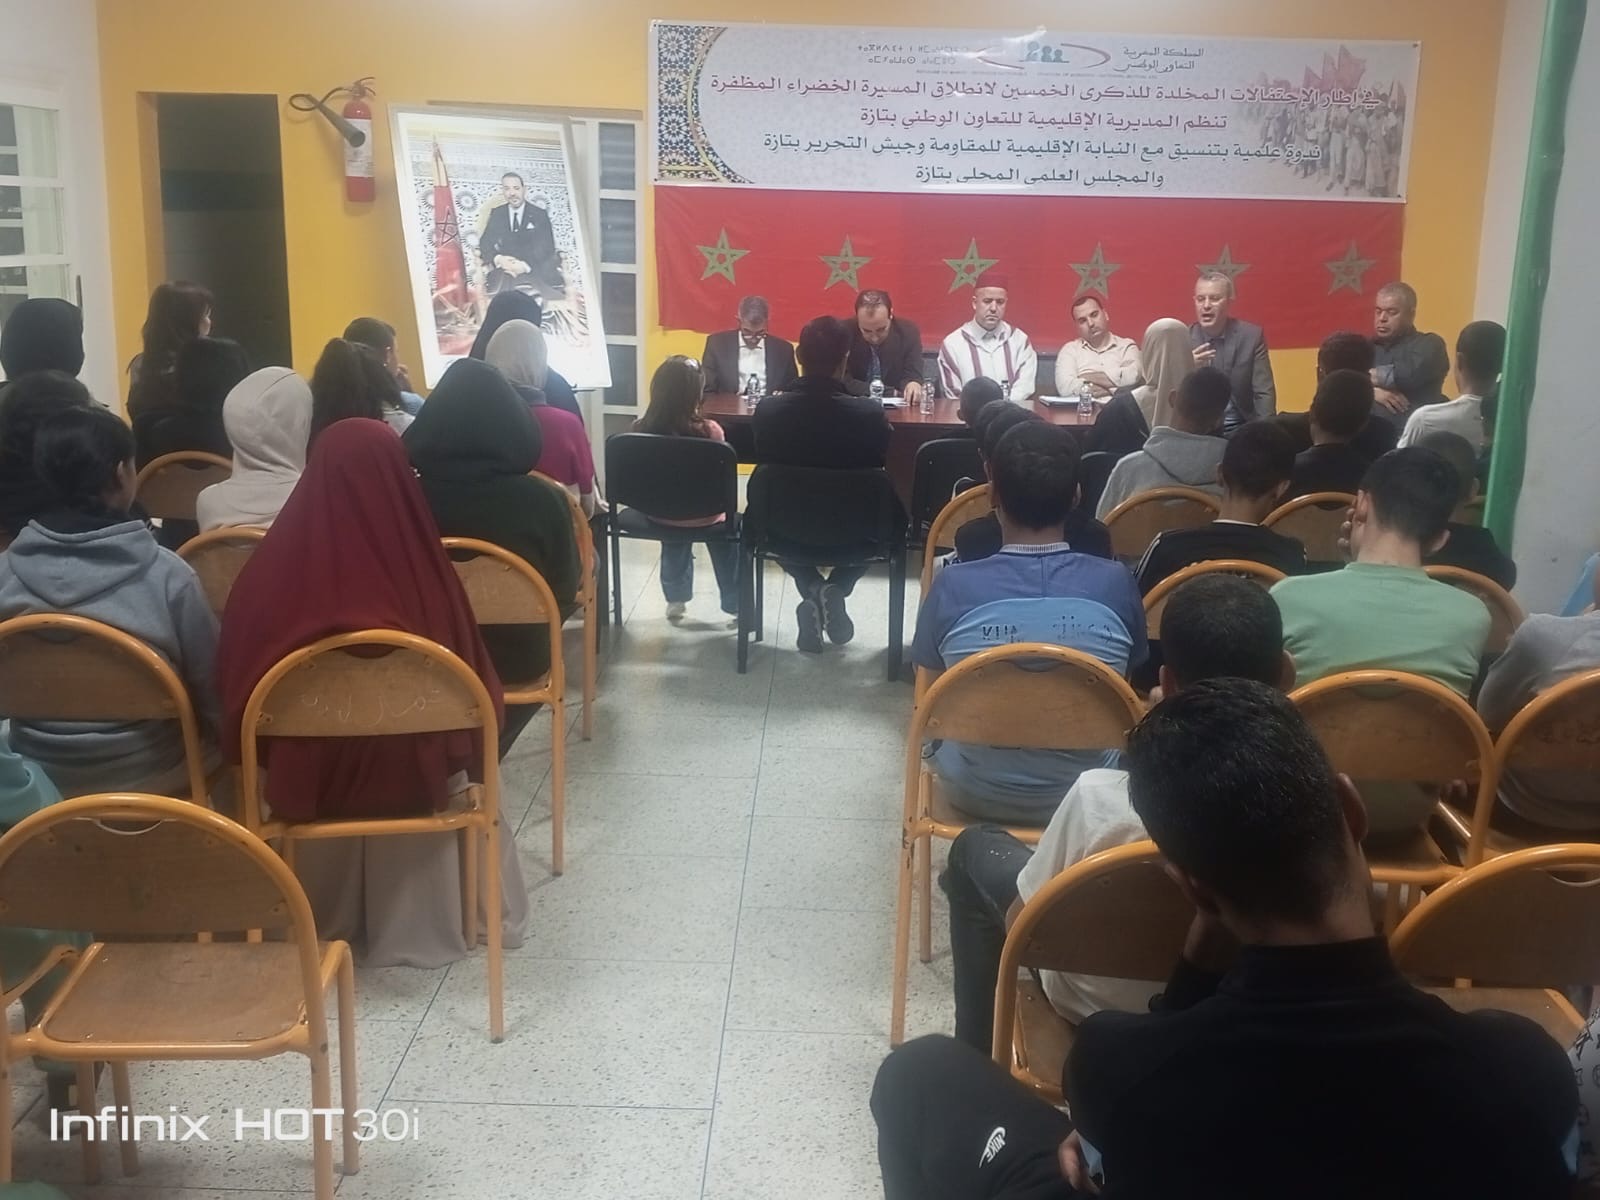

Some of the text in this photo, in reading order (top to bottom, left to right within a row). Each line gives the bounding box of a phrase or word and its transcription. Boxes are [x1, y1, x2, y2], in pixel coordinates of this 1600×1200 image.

[711, 74, 1381, 109] في إطار الإحتفالات المخلدة للذكرى الخمسين لانطلاق المسيرة الخضراء المظفرة
[860, 107, 1228, 134] تنظم المديرية الإقليمية للتعاون الوطني بتازة
[763, 133, 1321, 163] ندوة علمية بتنسيق مع النيابة الإقليمية للمقاومة وجيش التحرير بتازة
[915, 165, 952, 184] بتازة
[1083, 169, 1165, 188] والمجلس
